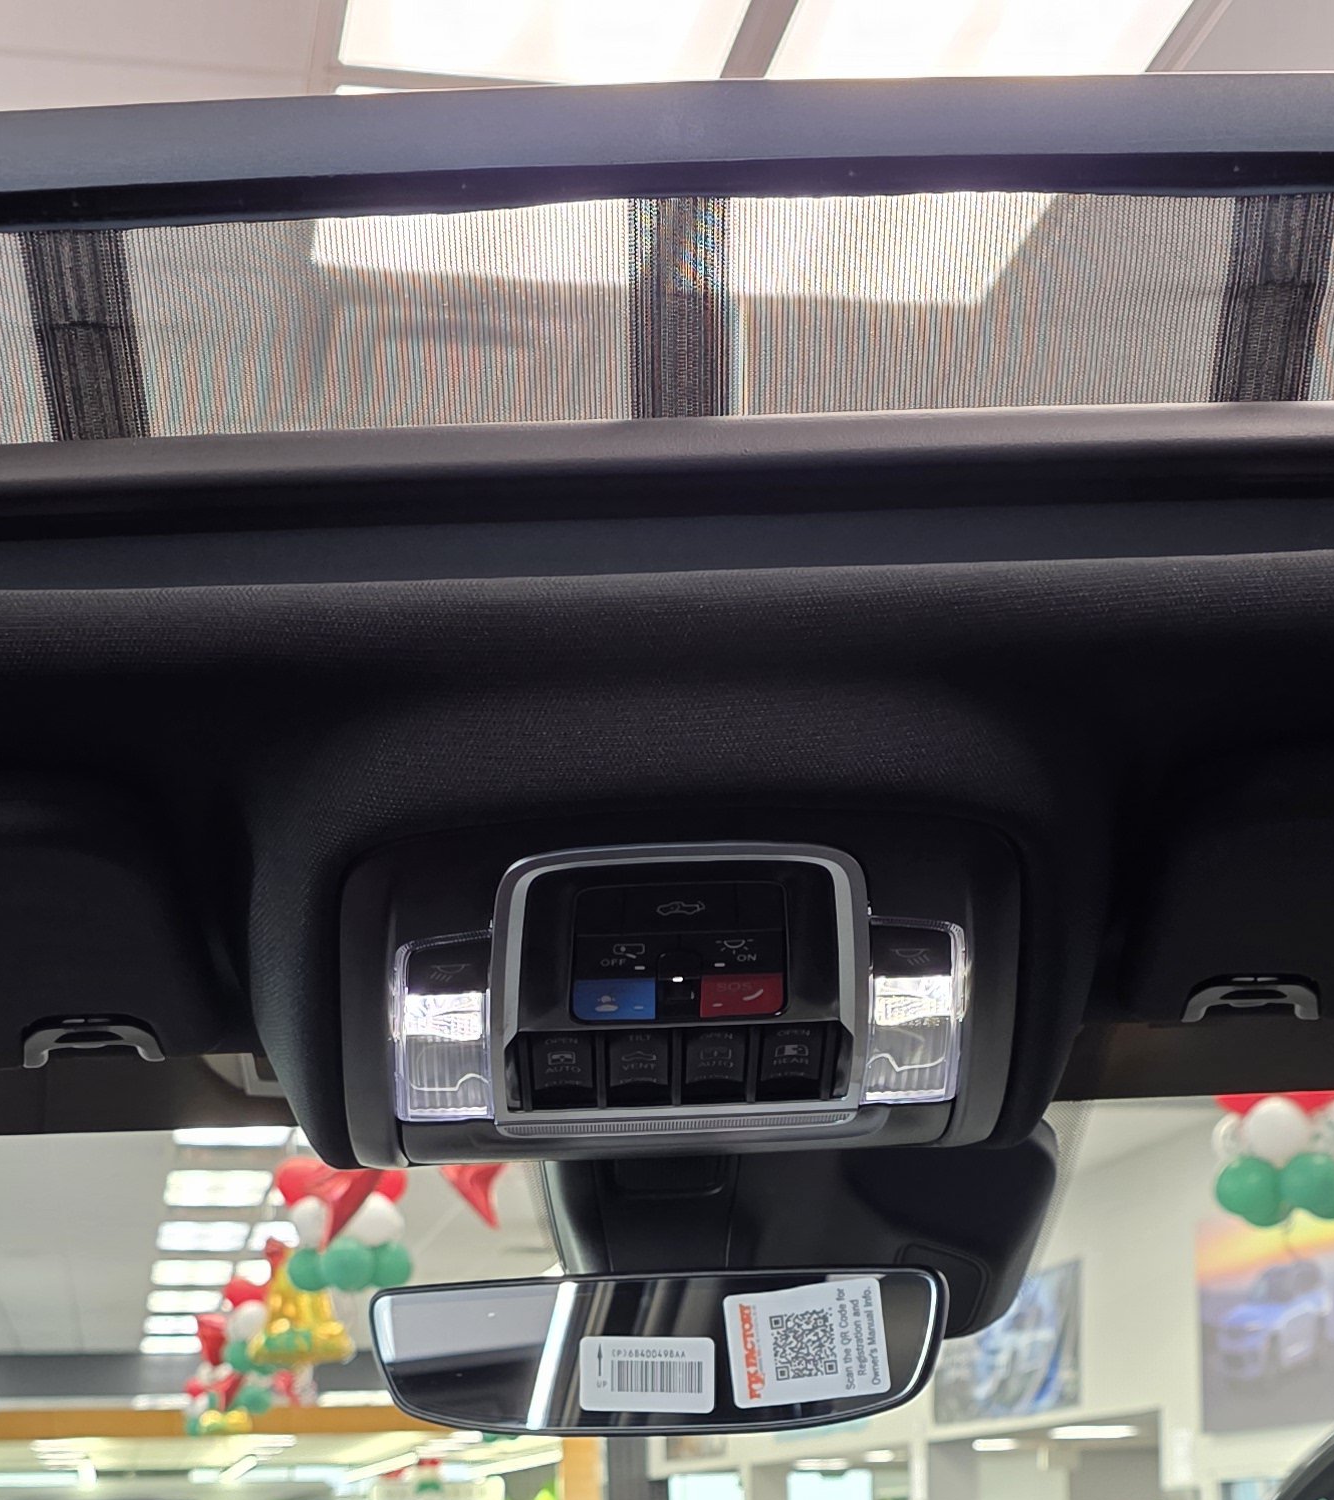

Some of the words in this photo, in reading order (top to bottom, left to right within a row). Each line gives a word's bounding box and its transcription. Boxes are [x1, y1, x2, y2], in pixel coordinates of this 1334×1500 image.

[600, 958, 627, 967] OFF
[736, 953, 757, 963] ON
[716, 981, 753, 992] SOS
[545, 1065, 582, 1074] AUTO
[621, 1062, 657, 1071] VENT
[836, 1287, 846, 1302] for
[861, 1286, 873, 1308] Info.
[838, 1303, 849, 1328] Code
[849, 1298, 861, 1318] and
[739, 1303, 758, 1368] FACTORY
[864, 1310, 877, 1346] Manual
[840, 1330, 853, 1346] QR
[853, 1319, 869, 1377] Registration
[842, 1349, 853, 1365] the
[867, 1347, 882, 1386] Owner's
[596, 1380, 608, 1388] UP
[845, 1366, 856, 1391] Scan
